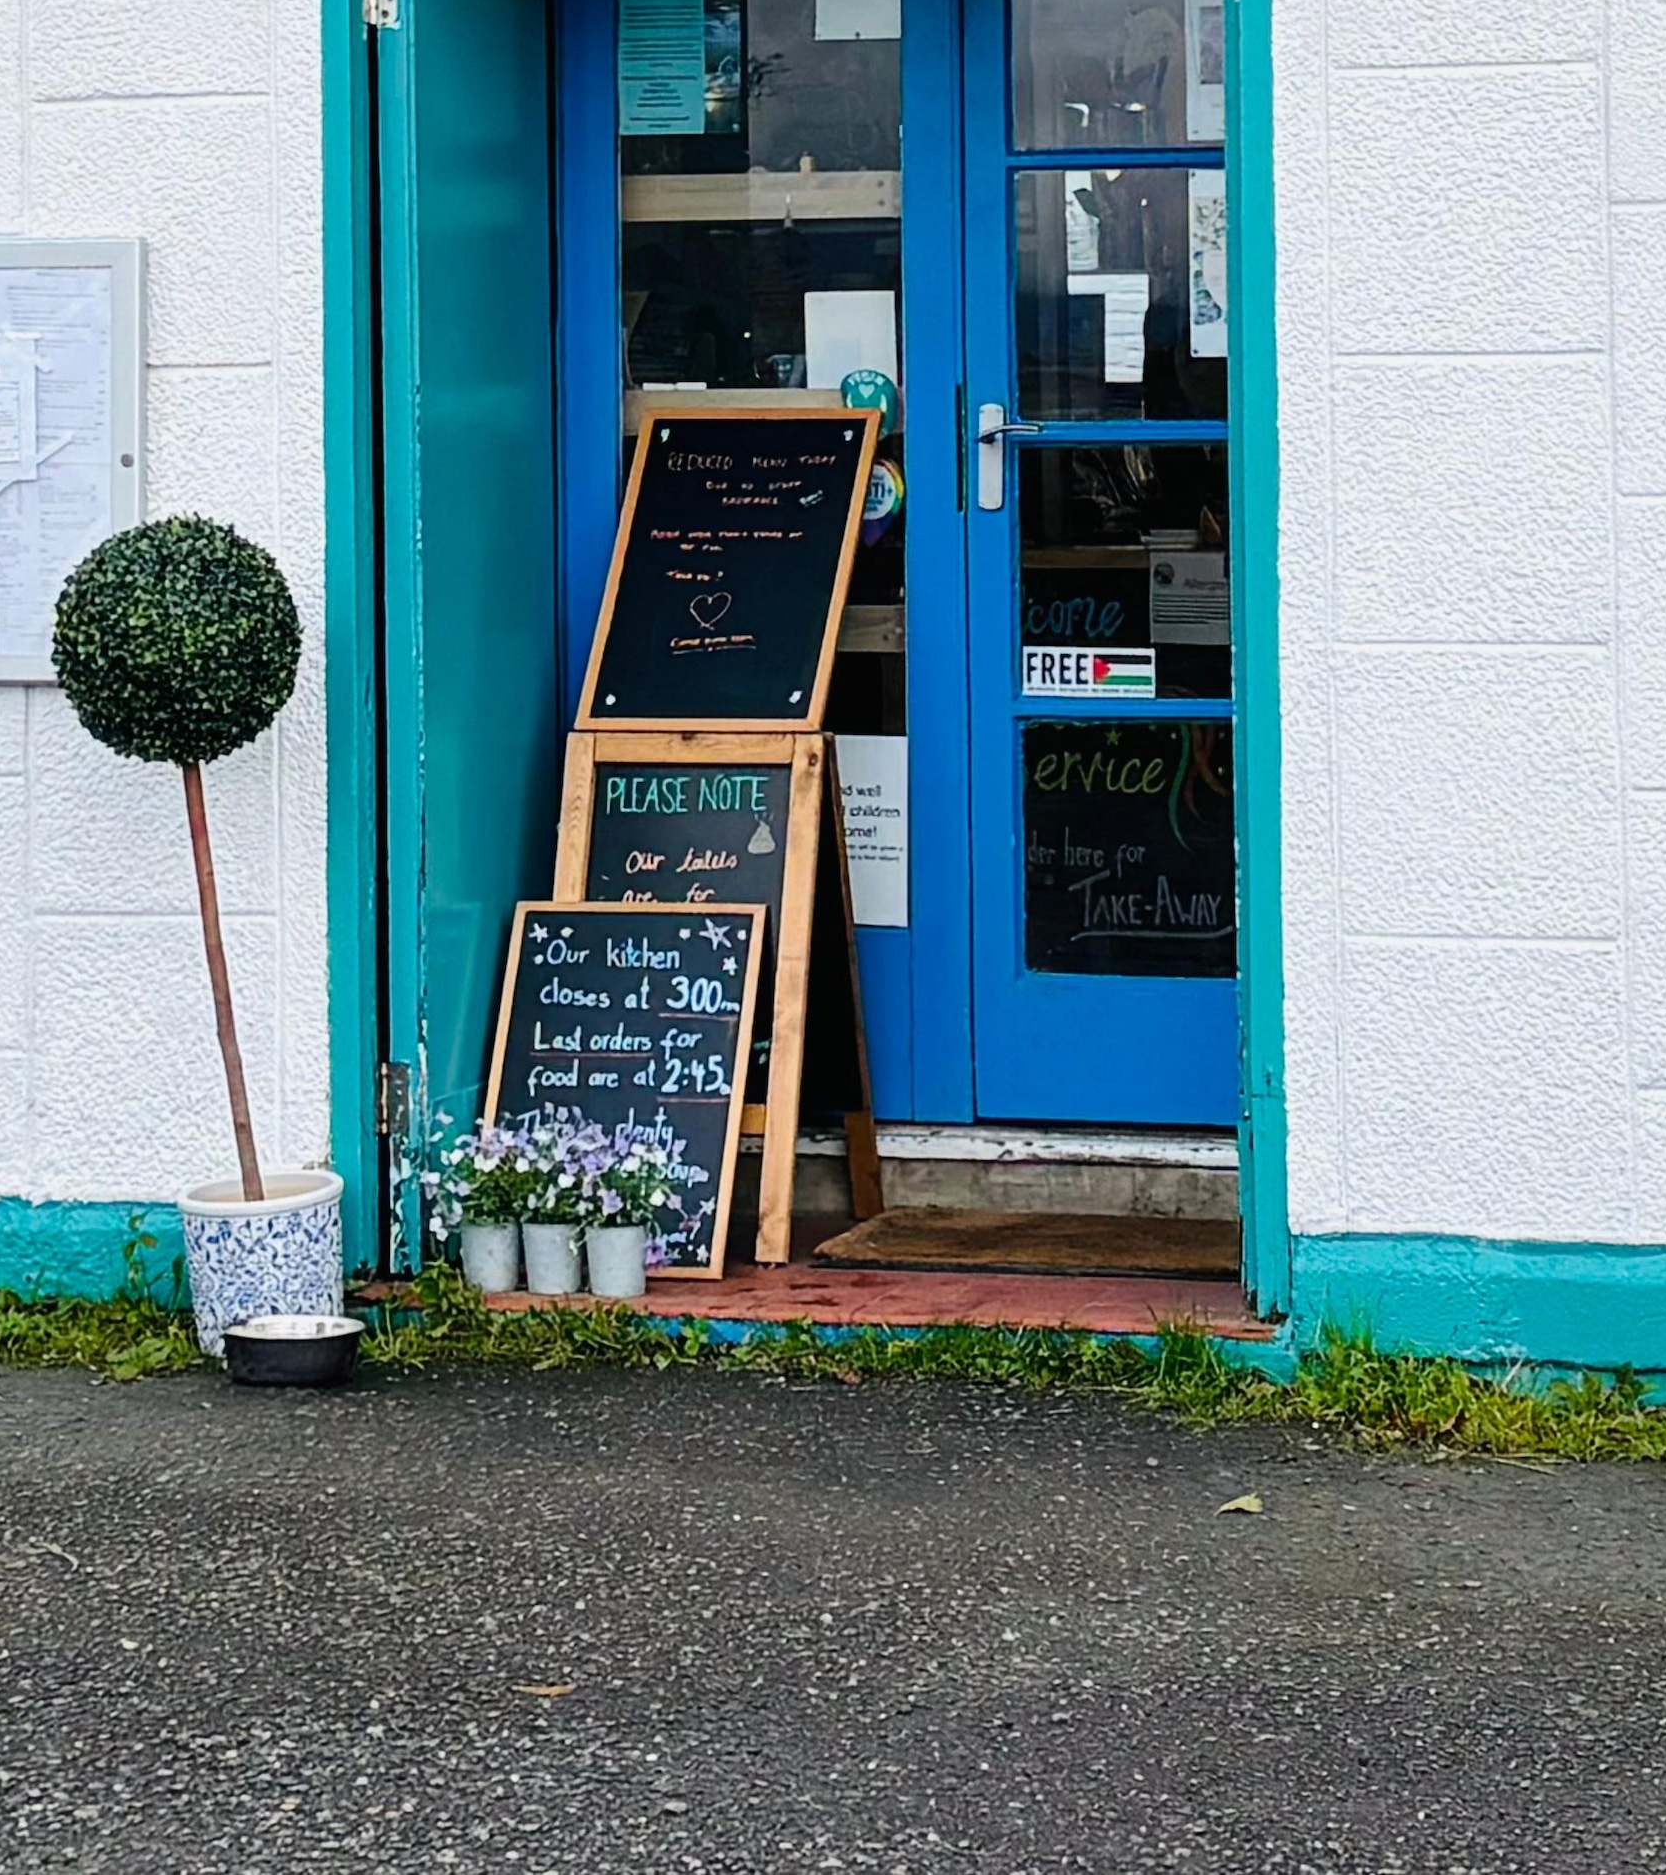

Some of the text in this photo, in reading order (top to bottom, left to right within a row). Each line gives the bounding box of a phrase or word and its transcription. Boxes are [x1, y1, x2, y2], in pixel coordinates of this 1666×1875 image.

[1026, 652, 1089, 686] FREE
[606, 774, 771, 815] PLEASE NOTE
[625, 850, 666, 875] Our
[1064, 826, 1106, 868] here
[1114, 843, 1147, 880] for
[546, 936, 681, 969] Our kitchen
[539, 976, 611, 1009] closes
[624, 975, 651, 1010] at
[533, 1021, 704, 1061] Last orders for
[527, 1058, 580, 1098] food
[588, 1072, 620, 1089] are
[632, 1059, 656, 1088] at
